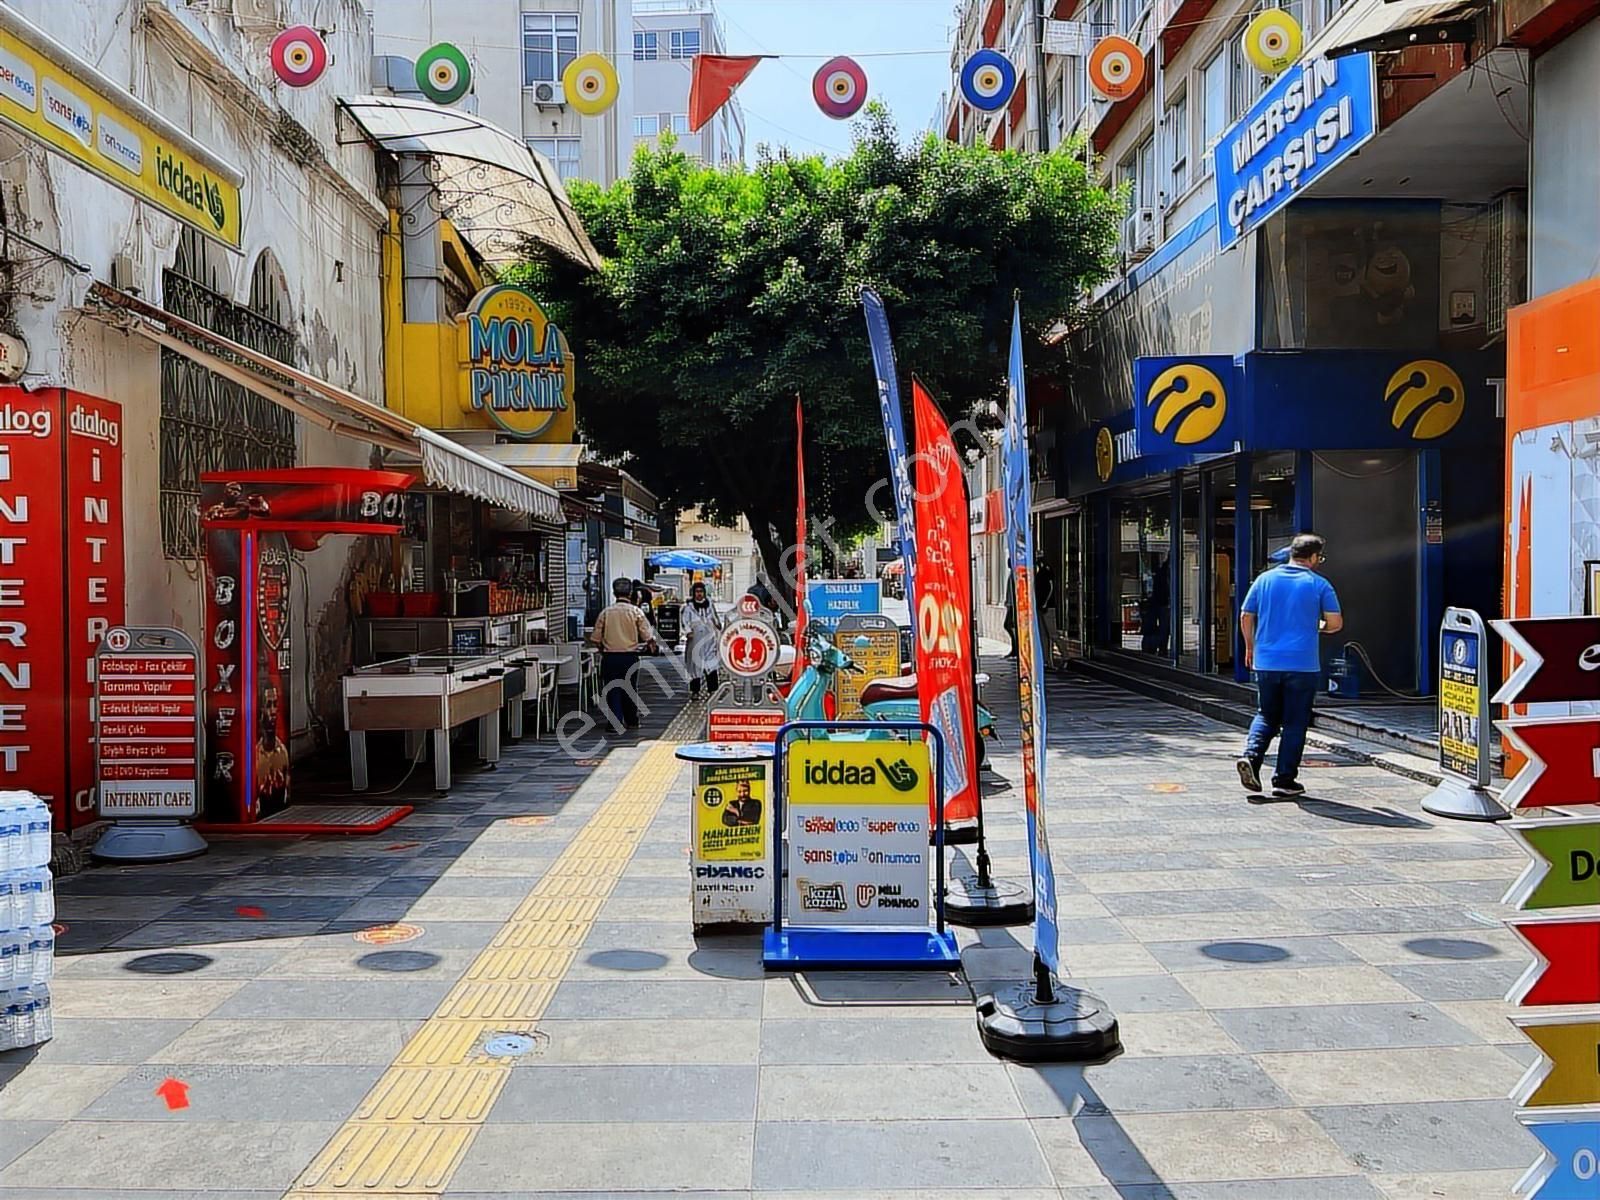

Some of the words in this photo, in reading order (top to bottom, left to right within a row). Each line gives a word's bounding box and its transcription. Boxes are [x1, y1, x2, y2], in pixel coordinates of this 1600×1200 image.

[1232, 57, 1339, 174] MERSİN
[155, 147, 204, 212] iddaa
[1228, 95, 1353, 236] ÇARŞISI
[469, 314, 565, 367] MOLA
[70, 404, 118, 446] dialog
[103, 681, 140, 692] Tarama
[143, 681, 172, 694] Yapılır
[213, 576, 235, 781] BOXER
[805, 759, 876, 785] iddaa
[104, 790, 162, 808] İNTERNET
[164, 791, 192, 807] CAFE
